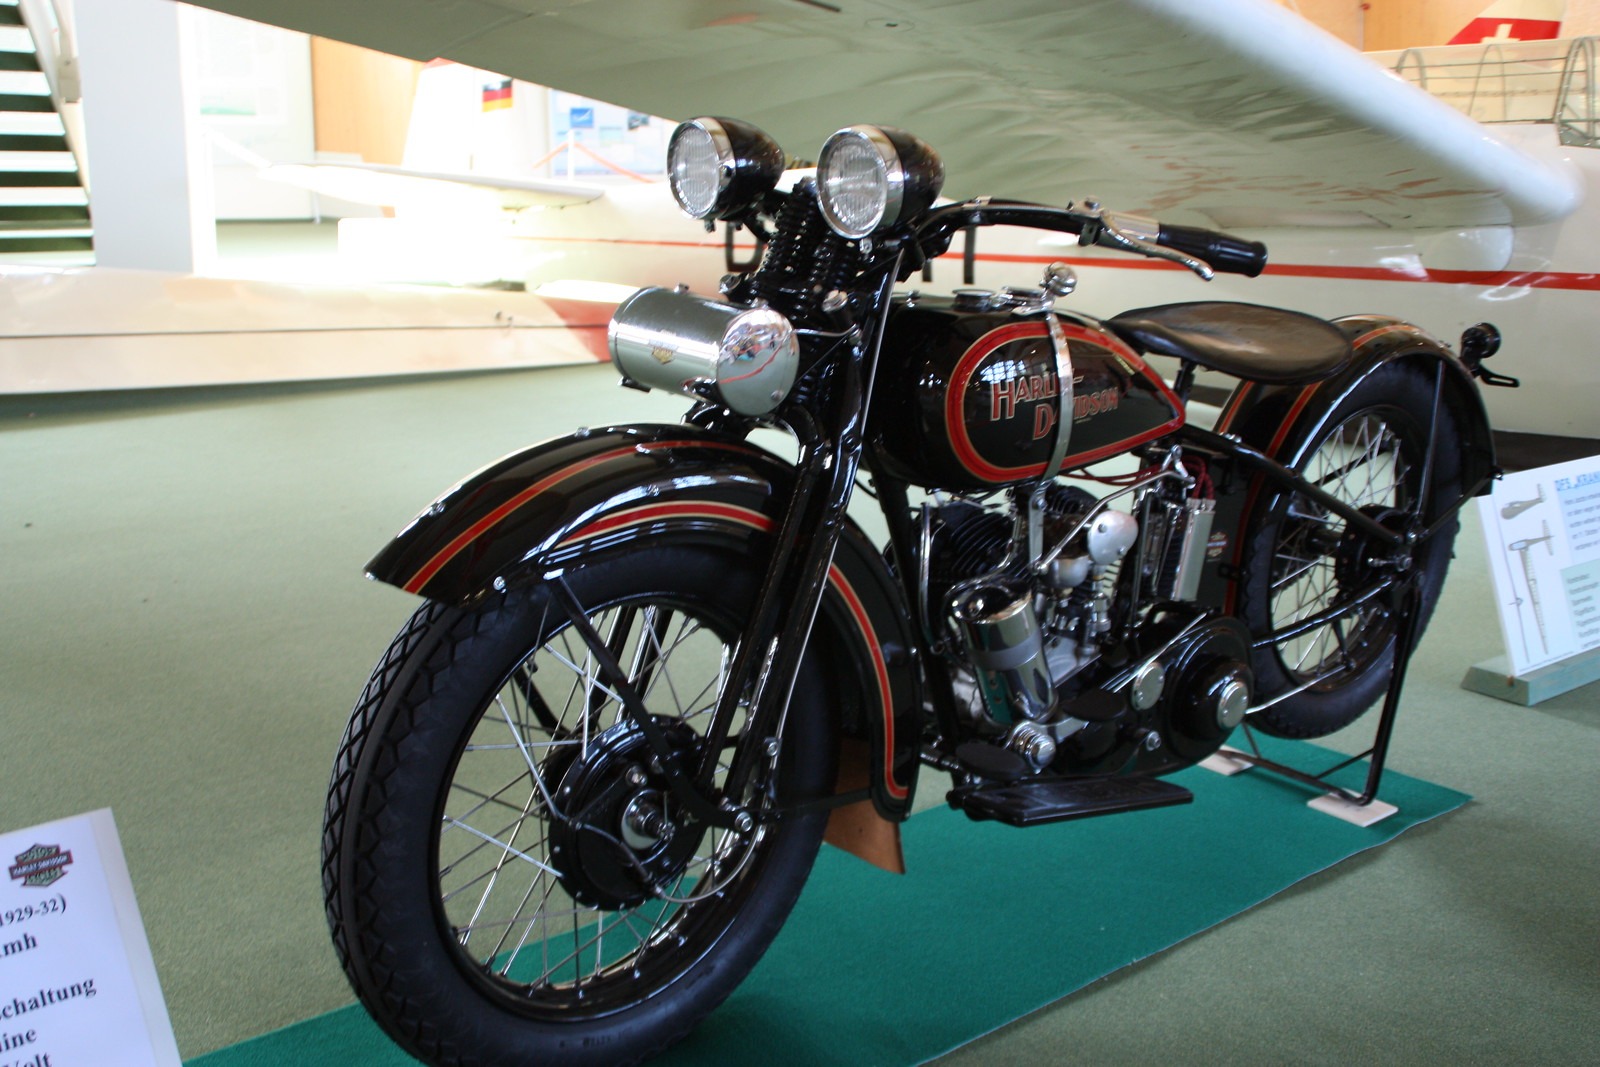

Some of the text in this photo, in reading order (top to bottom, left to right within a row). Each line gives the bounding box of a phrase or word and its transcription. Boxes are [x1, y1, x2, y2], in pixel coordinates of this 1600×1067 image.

[1032, 386, 1119, 441] DIDSON
[0, 932, 37, 958] mh
[0, 977, 97, 1020] chaltung
[0, 1029, 37, 1053] ine
